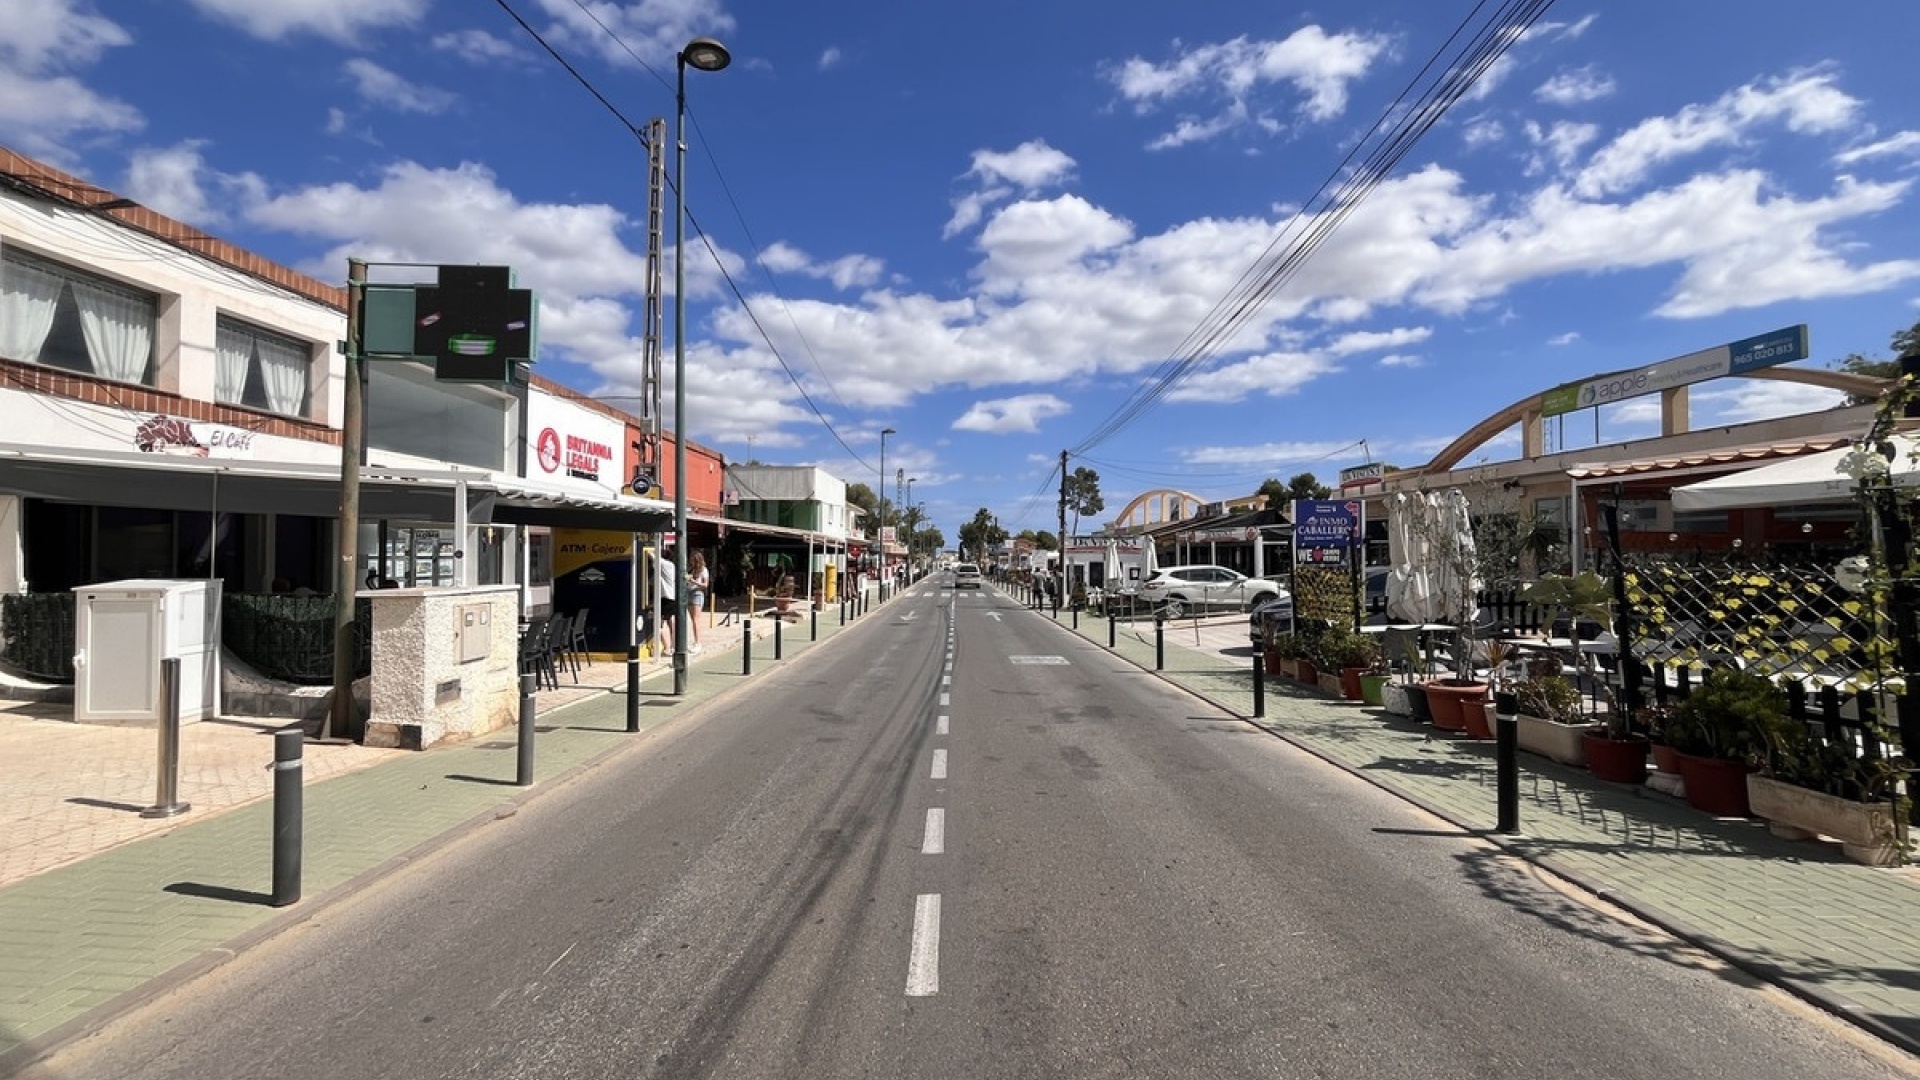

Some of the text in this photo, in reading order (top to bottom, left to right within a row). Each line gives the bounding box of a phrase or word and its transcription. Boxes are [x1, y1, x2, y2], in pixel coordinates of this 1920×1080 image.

[1734, 352, 1753, 364] 965
[1754, 347, 1775, 360] 020
[1775, 342, 1794, 355] 813
[1599, 373, 1647, 399] apple
[210, 430, 254, 451] El Café
[566, 433, 612, 460] BRITANNIA
[566, 451, 599, 474] LEGALS
[1319, 517, 1348, 526] INMO
[561, 543, 626, 555] ATM Cajero
[1297, 549, 1313, 562] WE
